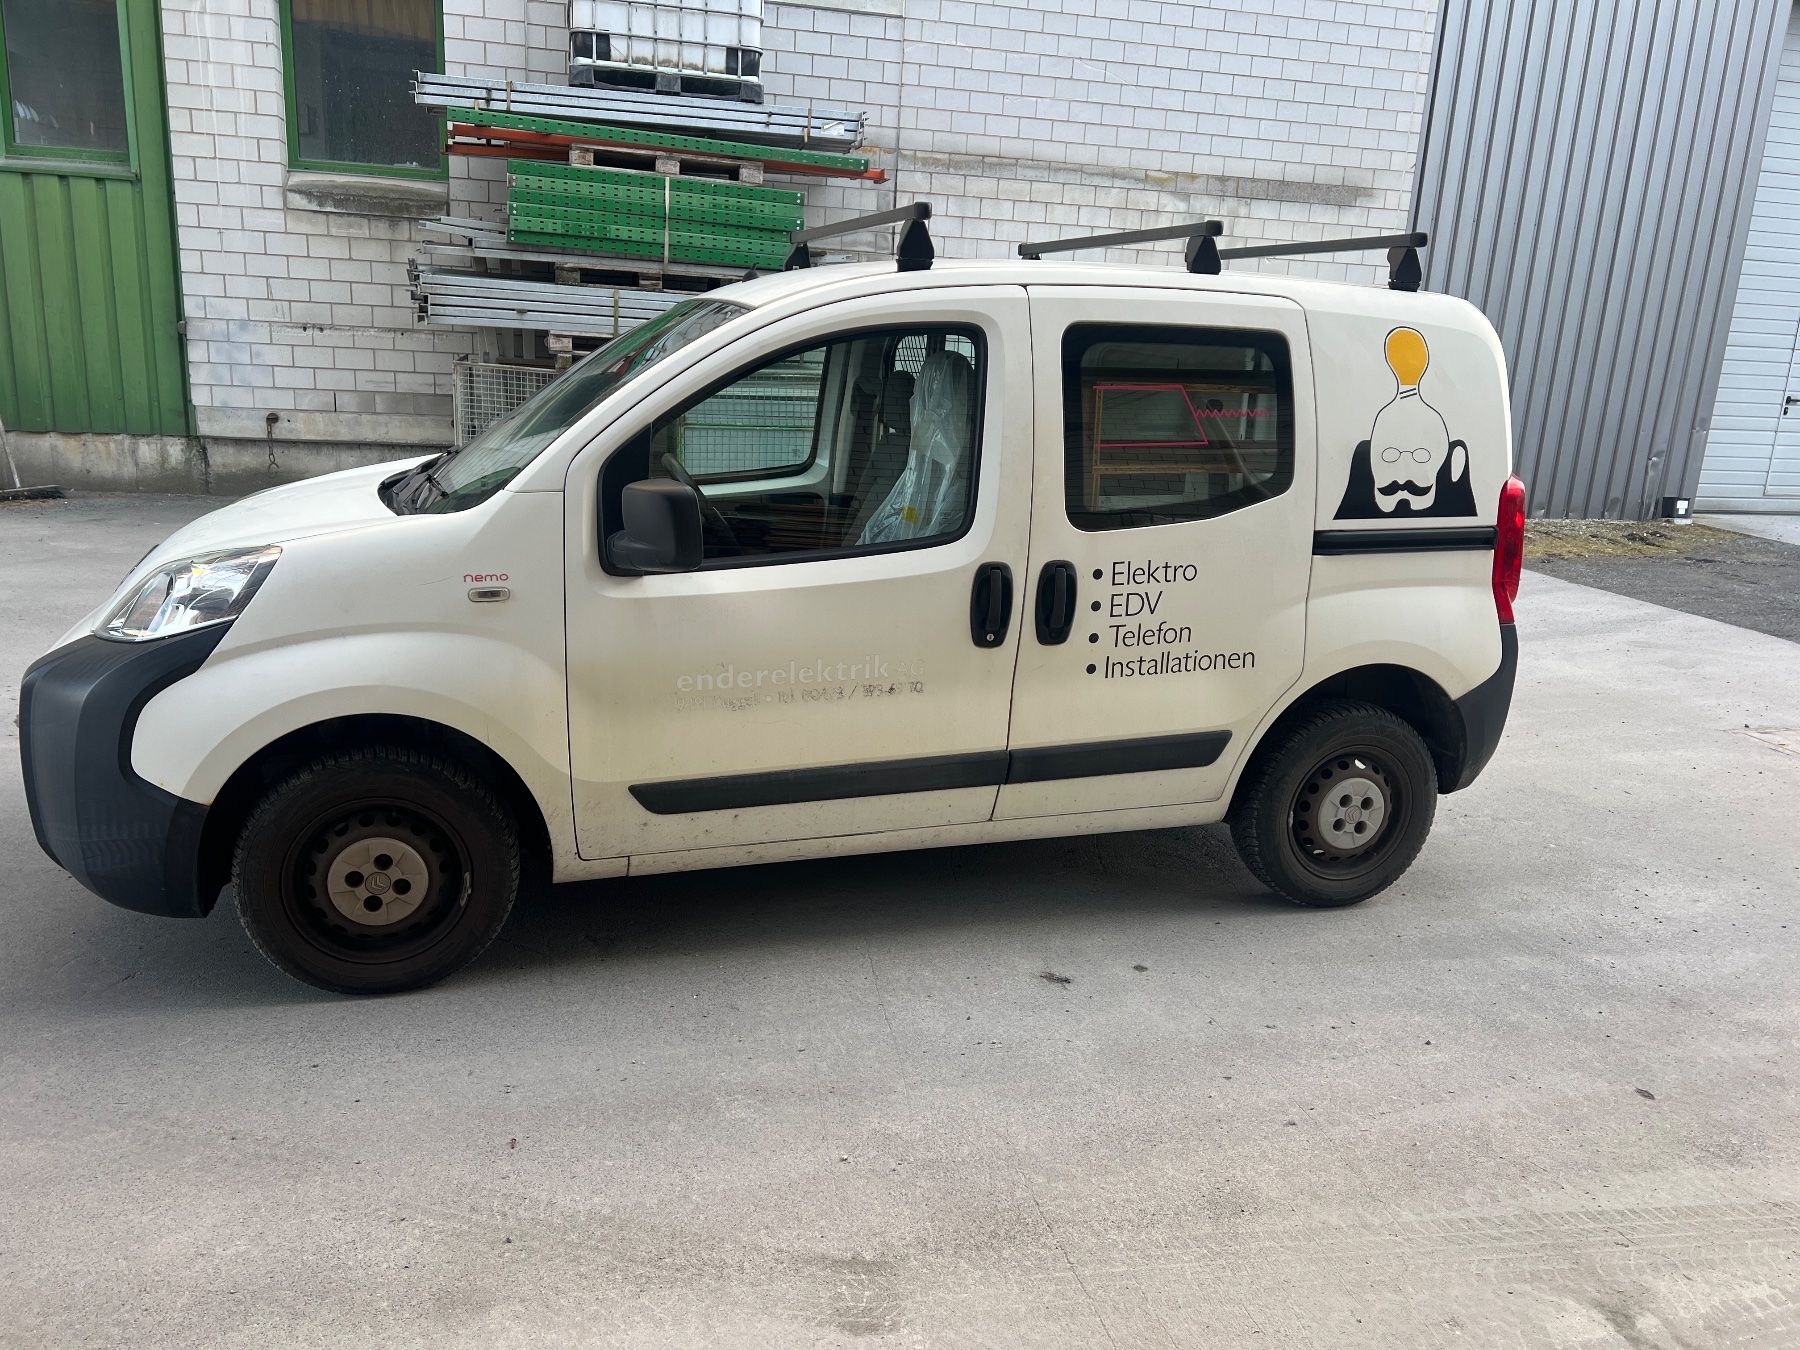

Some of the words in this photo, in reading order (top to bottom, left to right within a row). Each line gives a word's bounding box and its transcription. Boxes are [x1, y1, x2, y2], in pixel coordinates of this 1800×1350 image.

[463, 573, 509, 583] nemo
[1111, 560, 1198, 586] Elektro
[1109, 590, 1163, 618] EDV
[1109, 621, 1192, 648] Telefon
[676, 654, 889, 693] enderelektrik
[1104, 649, 1255, 679] Installationen
